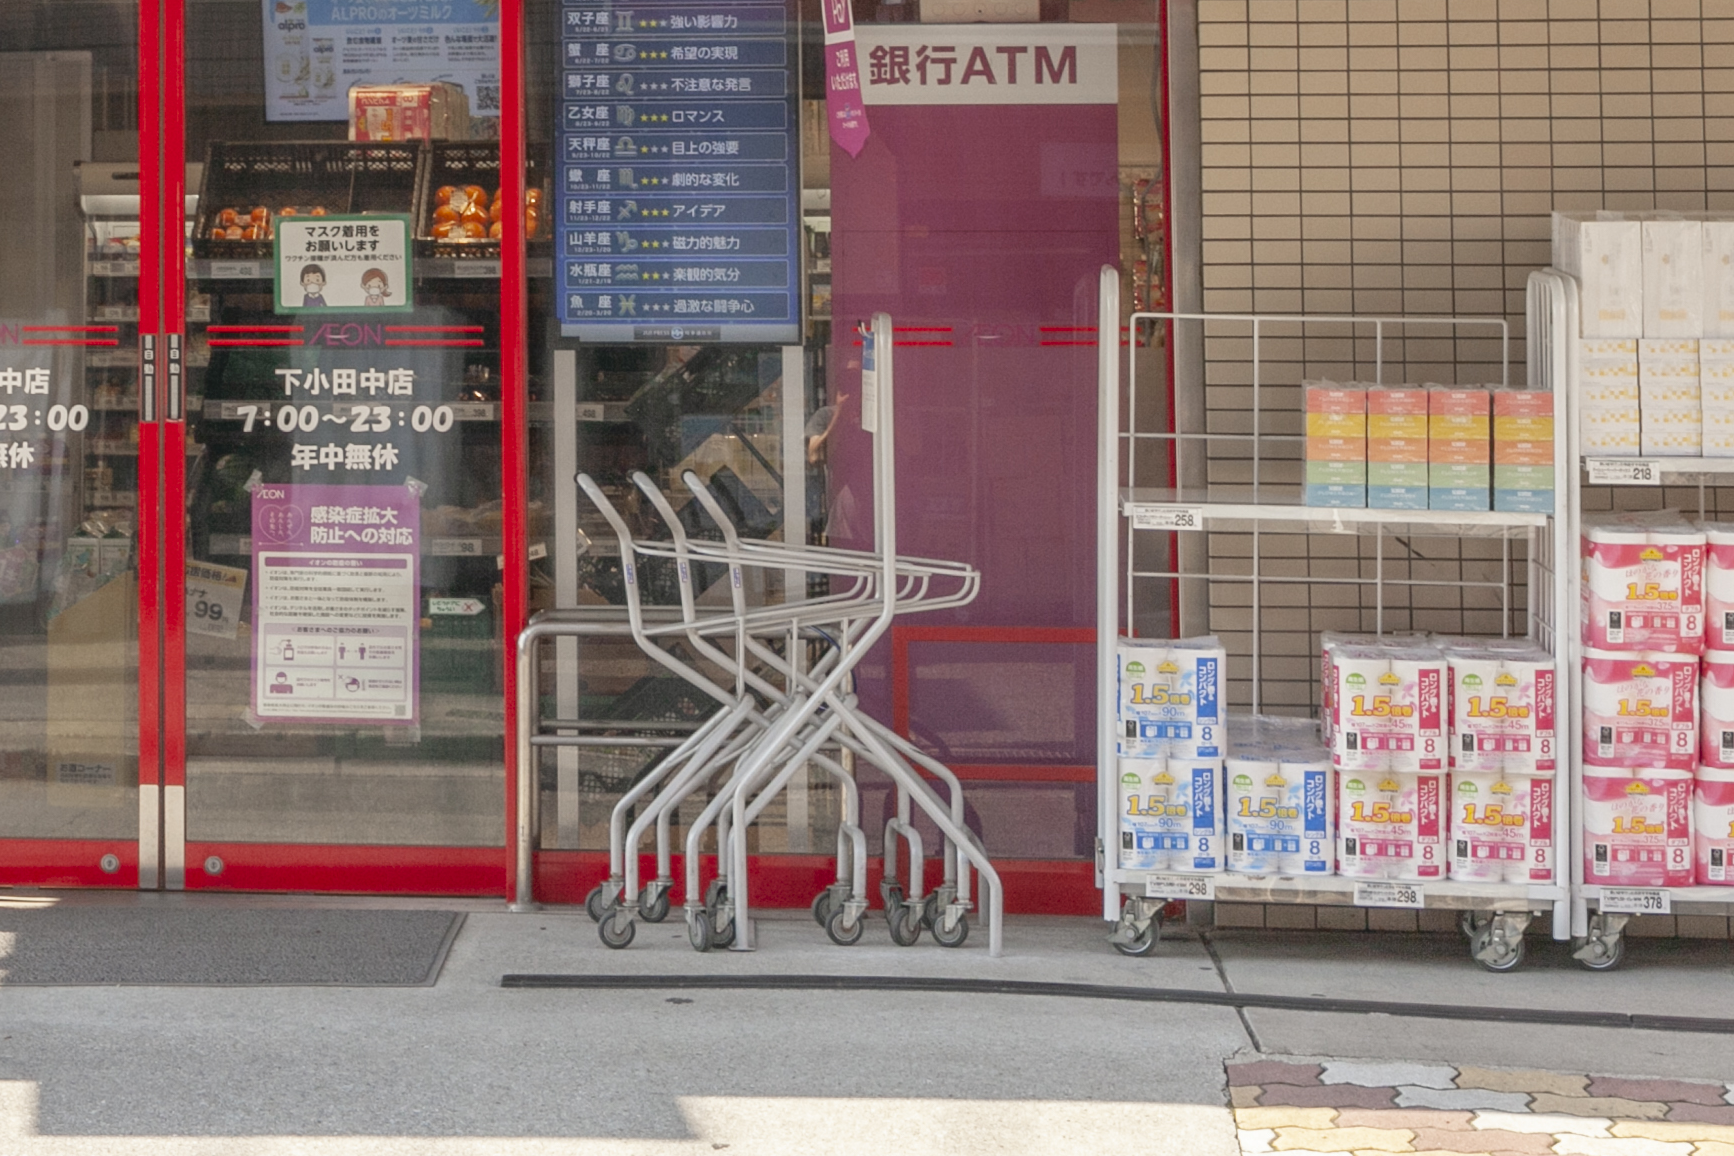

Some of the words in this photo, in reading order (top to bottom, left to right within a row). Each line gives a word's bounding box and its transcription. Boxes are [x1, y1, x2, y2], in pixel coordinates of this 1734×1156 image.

[331, 5, 453, 21] ALPROのオーツミルク
[567, 12, 609, 25] 双子座
[670, 15, 737, 29] 強い影響力
[278, 21, 305, 32] alpro
[671, 46, 738, 60] 希望の実現
[869, 45, 1078, 86] 銀行ATM
[568, 74, 610, 88] 獅子座
[671, 78, 751, 91] 不注意な発言
[568, 106, 609, 120] 乙女座
[672, 110, 725, 122] ロマンス
[568, 137, 610, 151] 天秤座
[672, 141, 739, 155] 目上の強要
[672, 173, 739, 186] 劇的な変化
[569, 201, 611, 214] 射手座
[673, 204, 726, 217] アイデア
[305, 225, 380, 238] マスク着用を
[305, 239, 380, 253] お願いします
[569, 232, 611, 246] 山羊座
[673, 236, 740, 250] 磁力的魅力
[570, 264, 611, 277] 水瓶座
[673, 268, 740, 281] 楽観的気分
[673, 300, 755, 313] 過激な闘争心
[274, 367, 414, 395] 下小田中店
[291, 443, 399, 471] 年中無休
[1633, 468, 1651, 480] 218
[310, 506, 398, 525] 感染症拡大
[1175, 514, 1194, 526] 258
[310, 527, 413, 545] 防止への対応
[1686, 615, 1696, 630] 8
[1199, 666, 1207, 705] コンパクト
[1675, 672, 1683, 713] コンパクト
[1421, 678, 1429, 717] コンパクト
[1202, 727, 1212, 740] 8
[1677, 732, 1687, 747] 8
[1425, 739, 1435, 753] 8
[1541, 739, 1550, 753] 8
[1195, 778, 1203, 817] コンパクト
[1421, 785, 1429, 824] コンパクト
[1533, 788, 1541, 827] コンパクト
[1669, 788, 1678, 829] コンパクト
[1198, 838, 1209, 852] 8
[1309, 841, 1320, 855] 8
[1423, 846, 1433, 860] 8
[1535, 848, 1545, 863] 8
[1673, 848, 1684, 864] 8
[1188, 882, 1207, 895] 298
[1396, 890, 1417, 903] 298
[1643, 896, 1662, 909] 378
